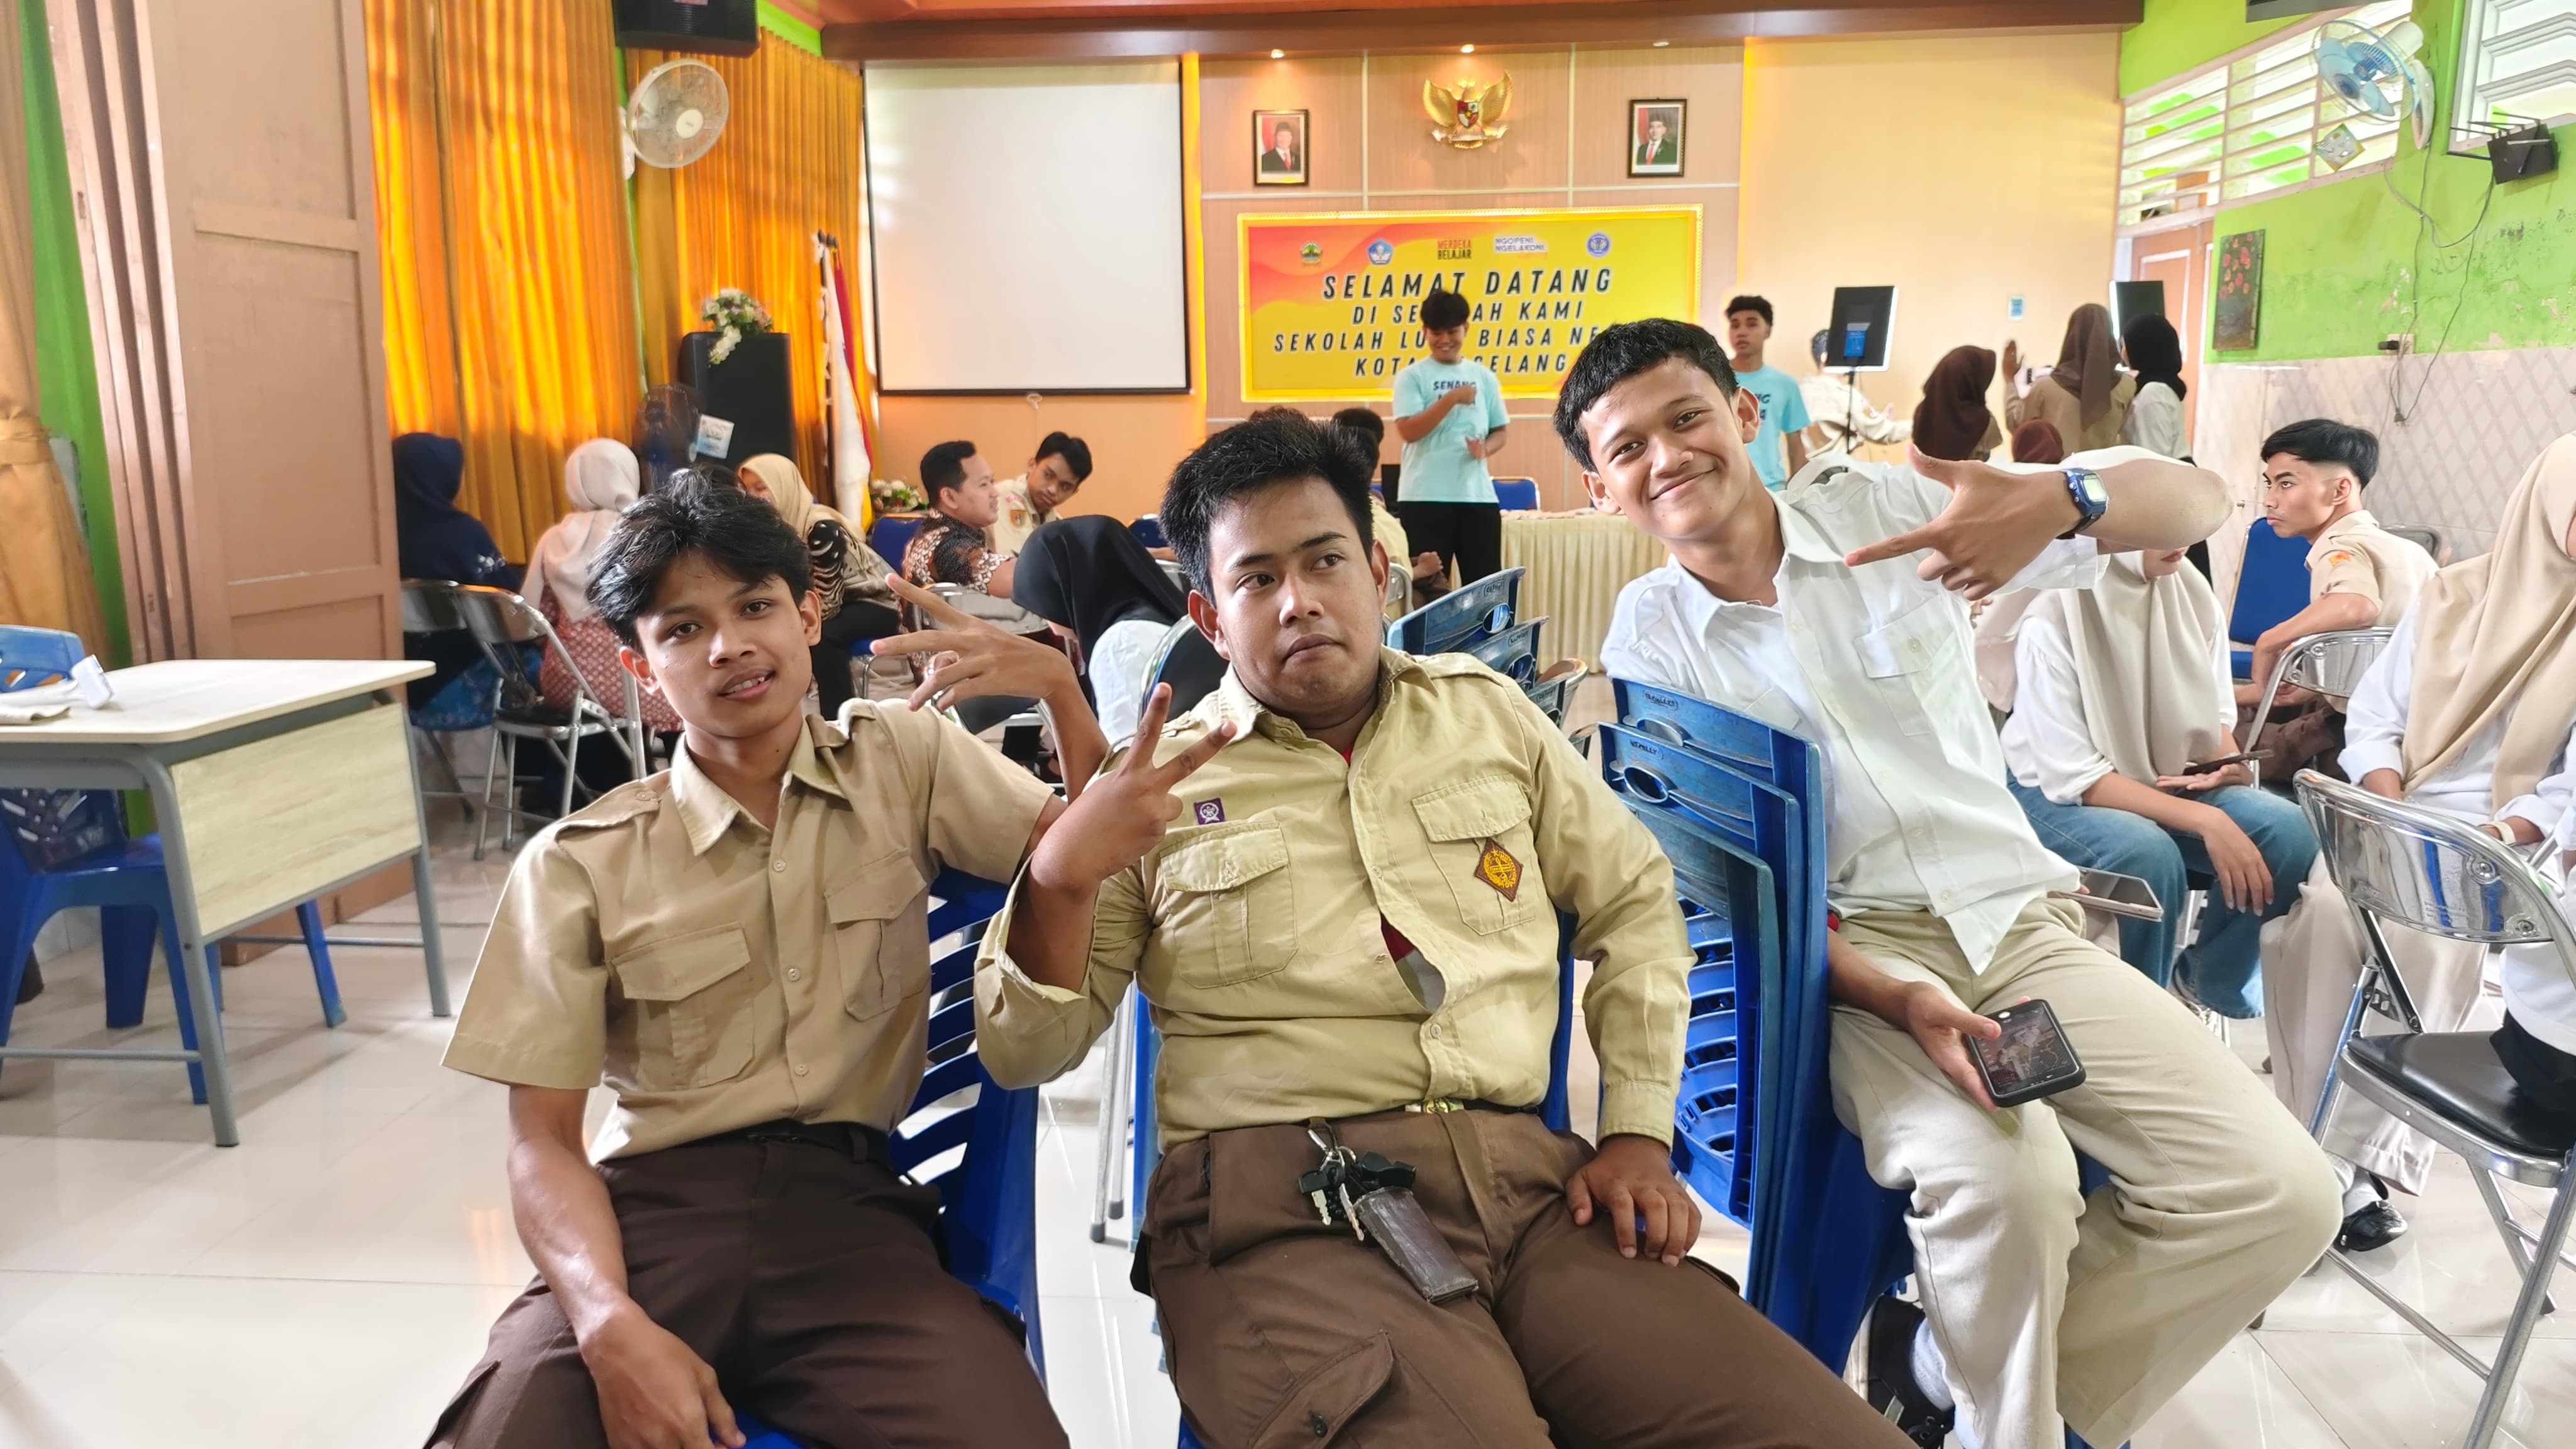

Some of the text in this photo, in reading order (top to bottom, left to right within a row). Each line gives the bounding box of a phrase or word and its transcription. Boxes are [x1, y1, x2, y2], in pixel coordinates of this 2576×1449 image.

[1438, 250, 1472, 260] BELAJAR
[1323, 268, 1611, 299] SELAMAT DATANG
[1353, 301, 1582, 324] DI SEAH KAMI
[1274, 331, 1383, 352] SEKOLAH
[1400, 330, 1426, 349] LU
[1478, 328, 1551, 347] BIASA
[1474, 354, 1566, 373] ELANG
